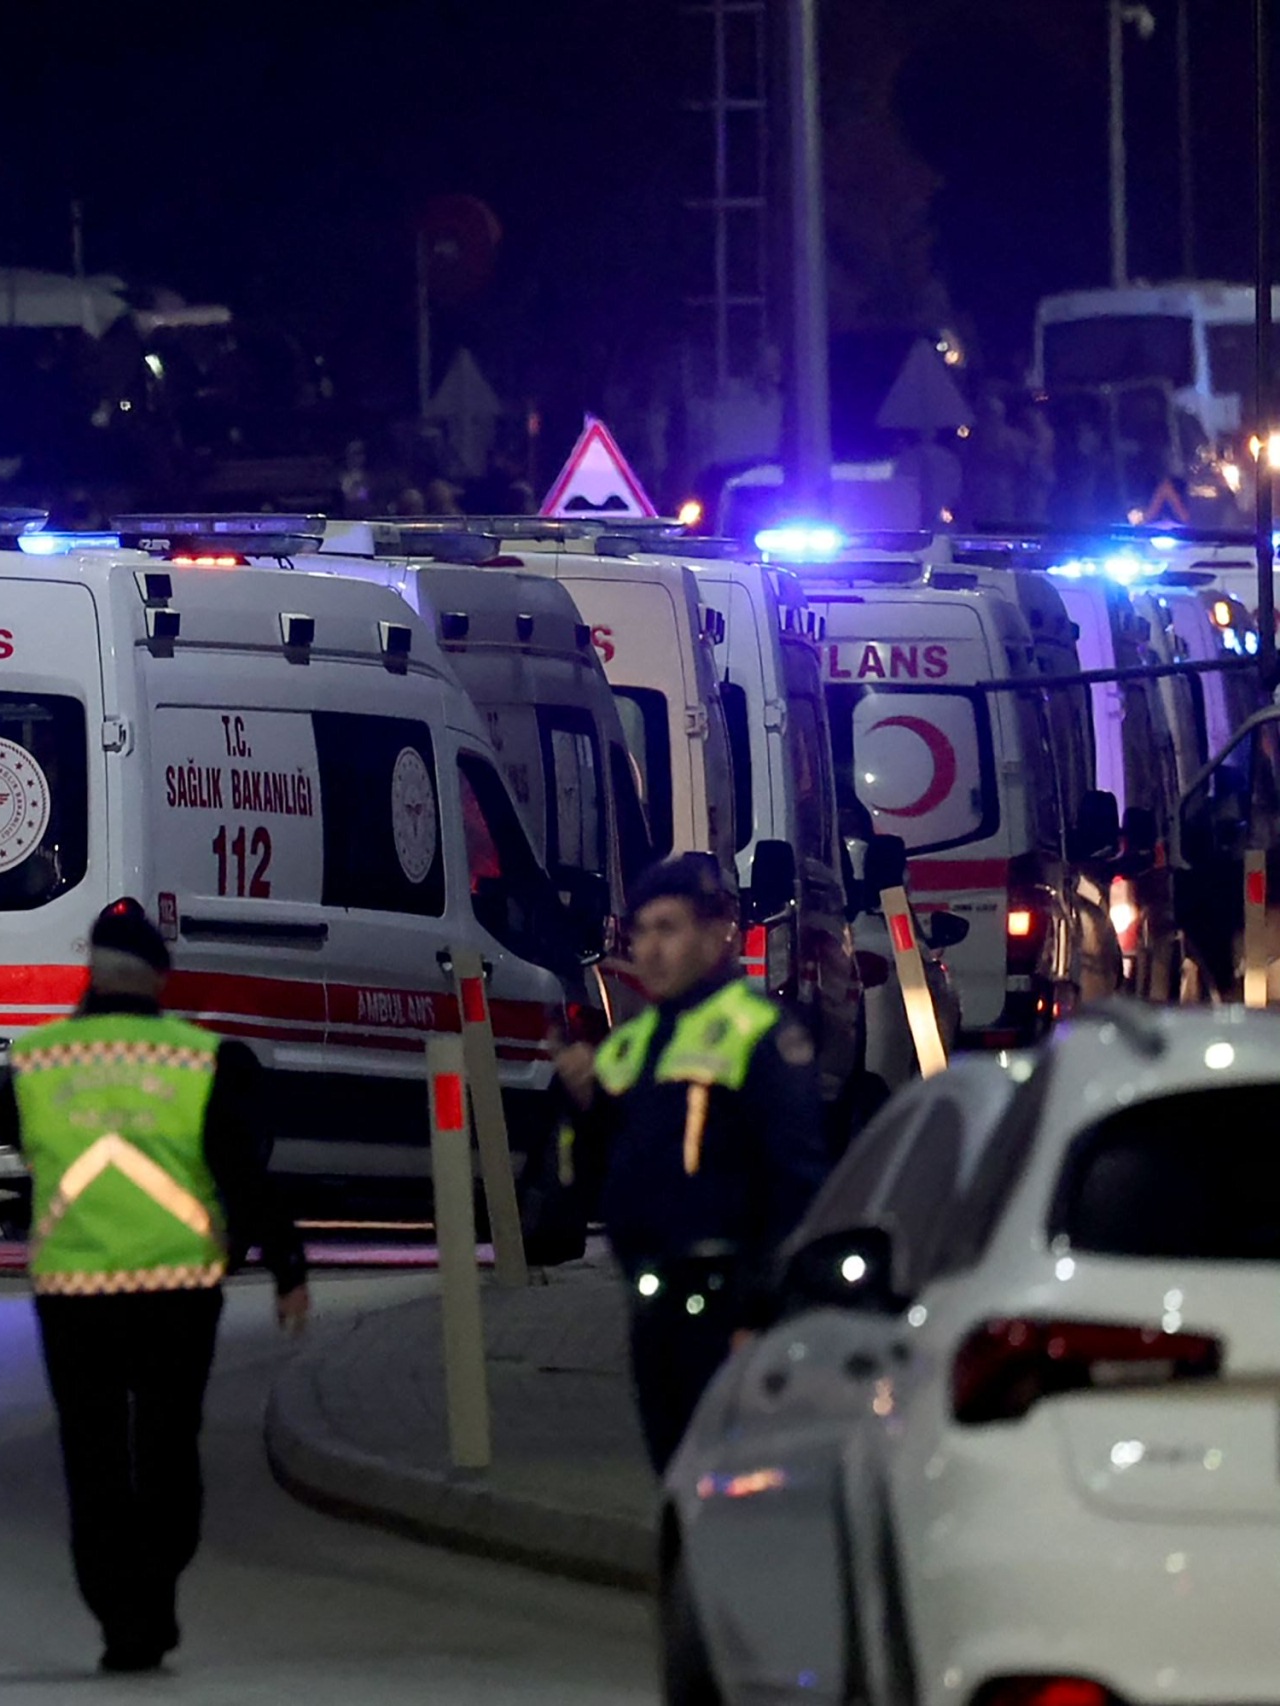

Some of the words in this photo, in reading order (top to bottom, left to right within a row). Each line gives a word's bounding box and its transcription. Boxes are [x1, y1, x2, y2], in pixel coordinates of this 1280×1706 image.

[816, 644, 949, 679] LANS
[221, 715, 252, 758] T.C.
[166, 757, 223, 808] SAĞLIK
[231, 767, 313, 817] BAKANLIĞI
[213, 825, 272, 898] 112
